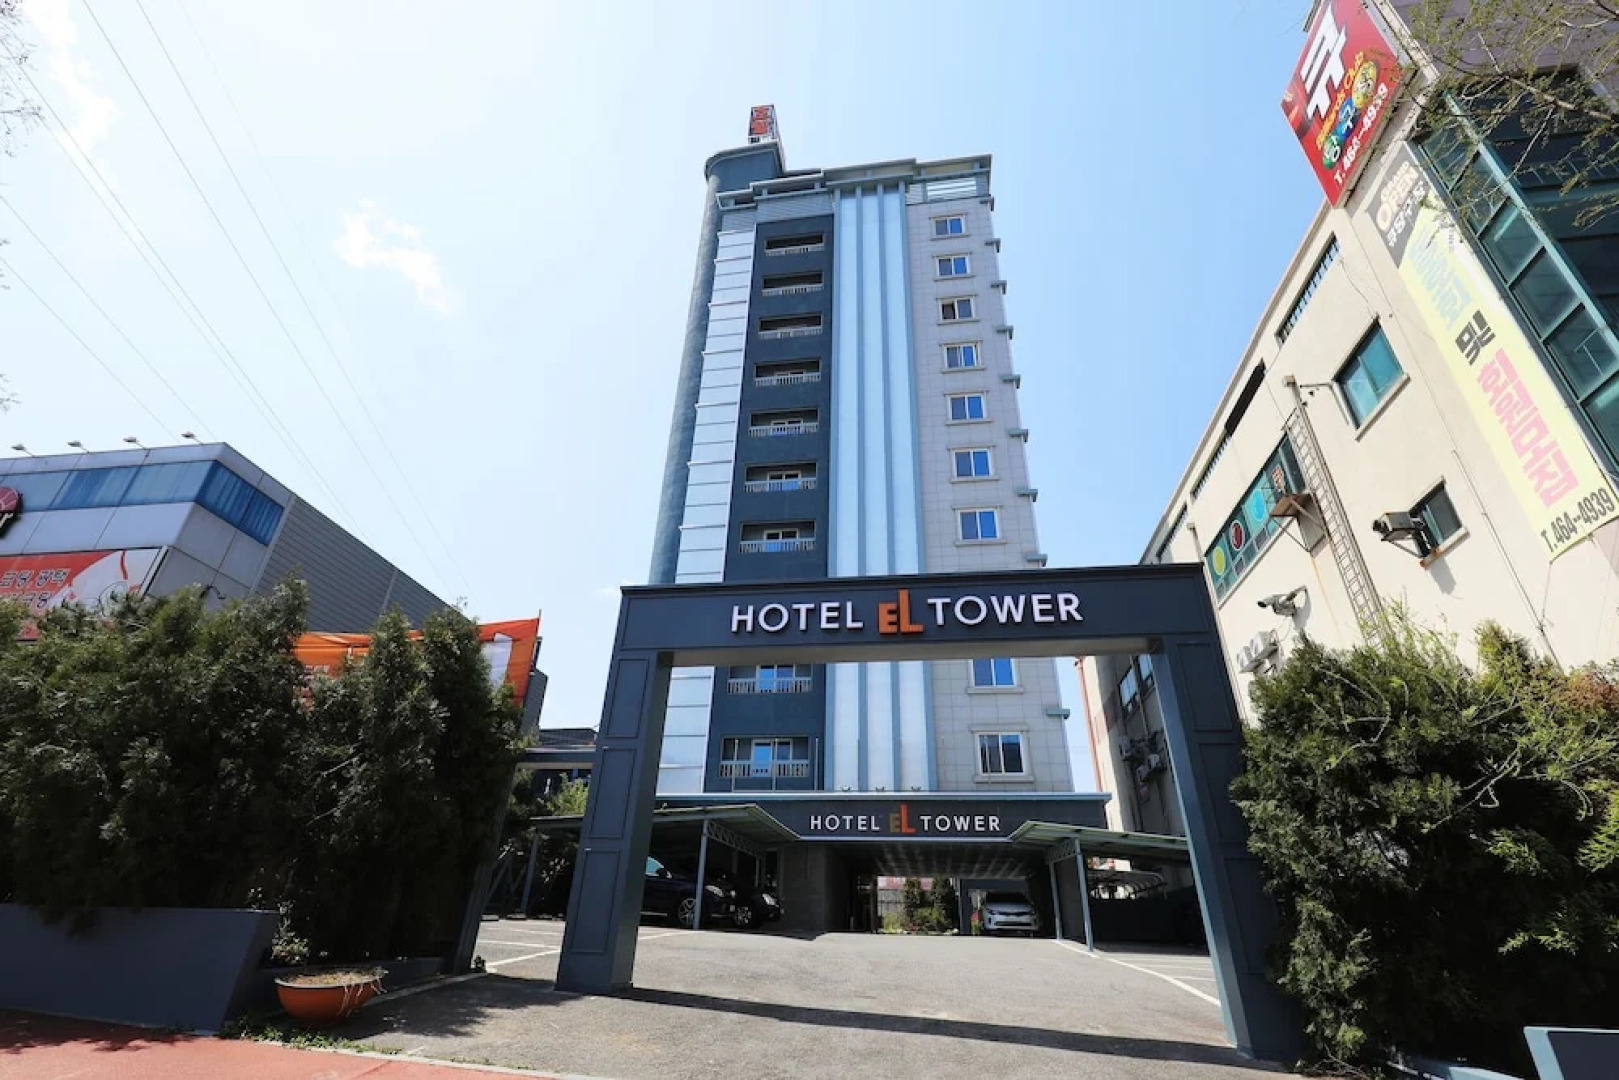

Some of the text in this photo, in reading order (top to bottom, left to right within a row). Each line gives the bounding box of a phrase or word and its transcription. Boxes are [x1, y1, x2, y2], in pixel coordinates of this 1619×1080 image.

[1375, 166, 1420, 232] OPEN
[1455, 310, 1495, 366] 및
[1476, 348, 1580, 508] 회원모집
[731, 601, 863, 633] HOTEL
[928, 593, 1084, 626] TOWER
[809, 814, 880, 832] HOTEL
[920, 814, 1001, 833] TOWER
